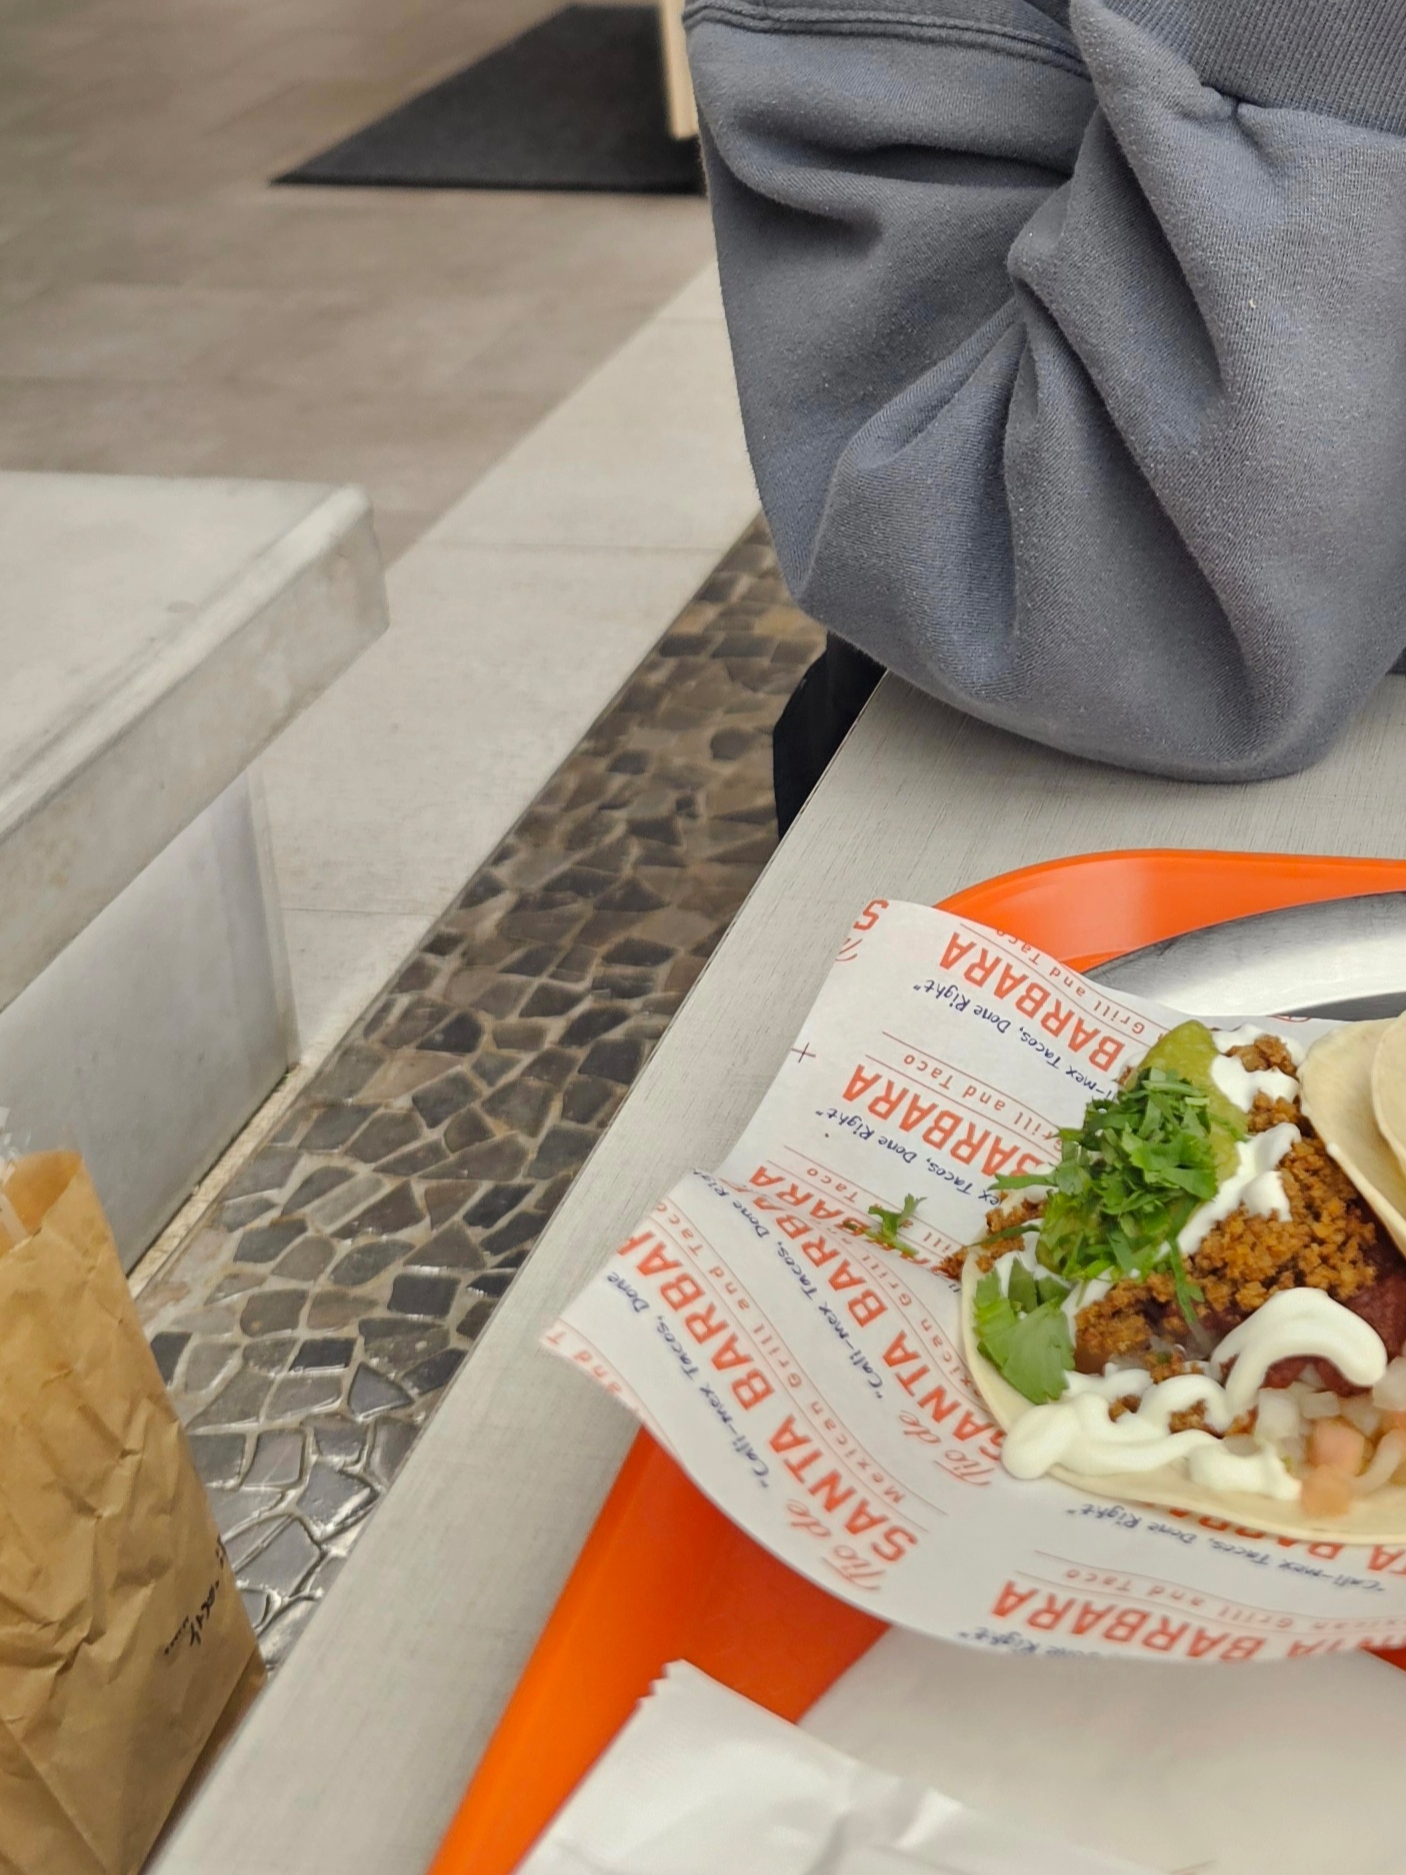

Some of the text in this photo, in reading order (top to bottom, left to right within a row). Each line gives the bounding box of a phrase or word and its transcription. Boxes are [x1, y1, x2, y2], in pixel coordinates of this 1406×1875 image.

[913, 979, 970, 1013] Right"
[1049, 967, 1086, 997] and
[938, 931, 1125, 1072] BARBARA
[973, 1004, 1011, 1034] Done
[1092, 999, 1146, 1036] Grill
[1019, 1026, 1062, 1068] Tacos,
[902, 1053, 953, 1090] Taco
[962, 1085, 1006, 1113] and
[814, 1107, 973, 1195] Tacos, Done Right"
[807, 1168, 858, 1203] Taco
[732, 1201, 770, 1238] Done
[606, 1271, 650, 1313] Done
[708, 1264, 750, 1311] and
[656, 1315, 699, 1380] Tacos,
[753, 1323, 802, 1389] Grill
[617, 1231, 917, 1562] SANTA BARBA
[899, 1411, 941, 1447] de
[808, 1401, 906, 1503] Mexican
[785, 1500, 831, 1540] de
[1065, 1569, 1131, 1593] Taco
[1148, 1586, 1204, 1606] and
[990, 1580, 1267, 1662] BARBARA
